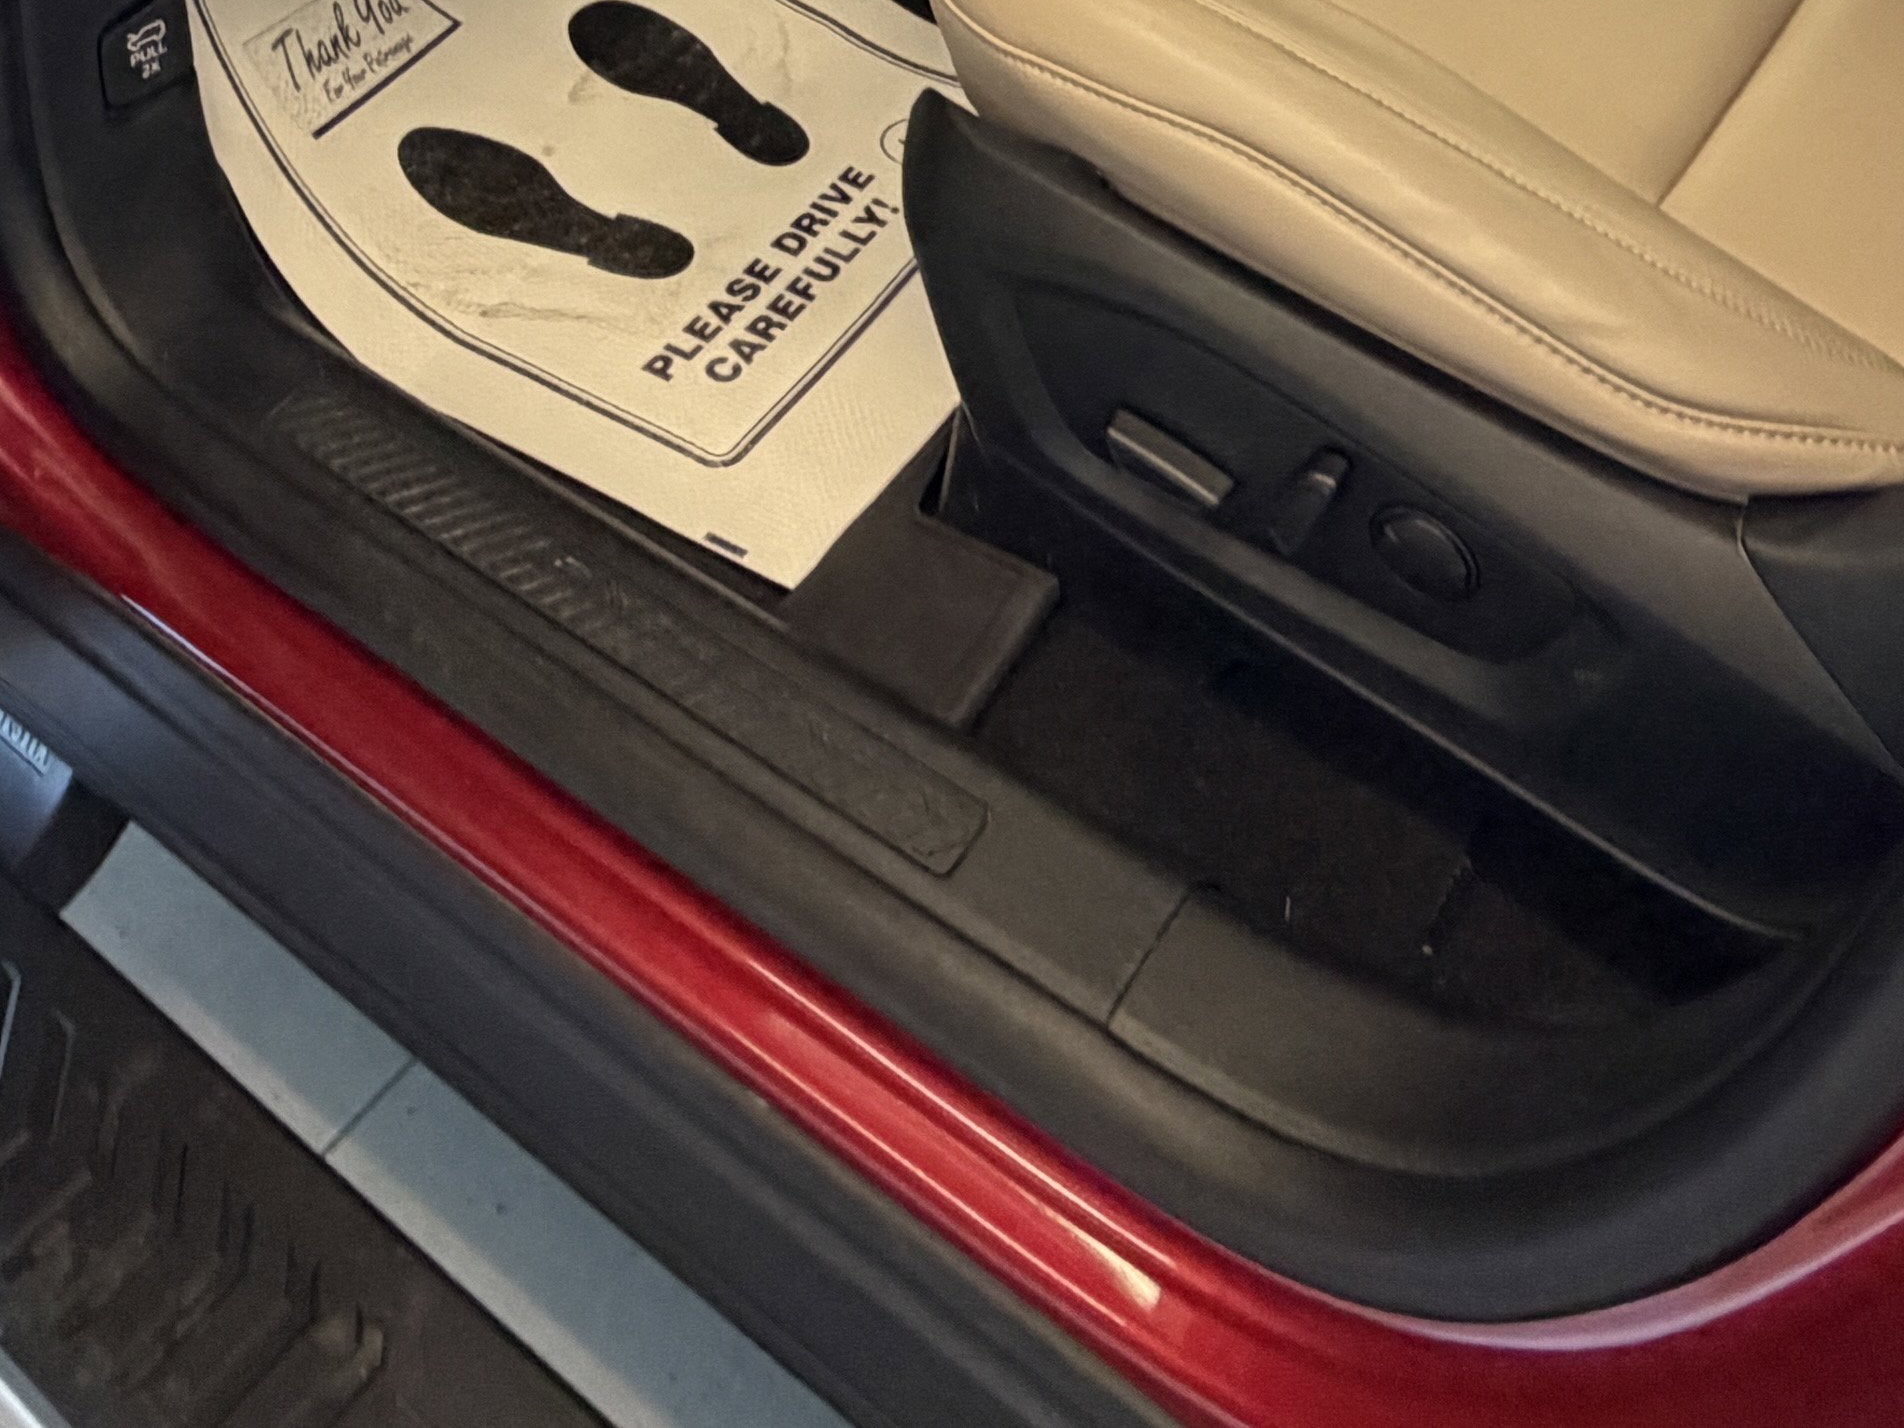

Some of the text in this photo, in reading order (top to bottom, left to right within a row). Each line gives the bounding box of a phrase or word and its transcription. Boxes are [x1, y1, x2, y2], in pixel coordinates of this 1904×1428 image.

[130, 40, 168, 69] PULL
[271, 1, 362, 93] Thank
[641, 165, 876, 383] PLEASE DRIVE
[704, 197, 901, 383] CAREFULLY!
